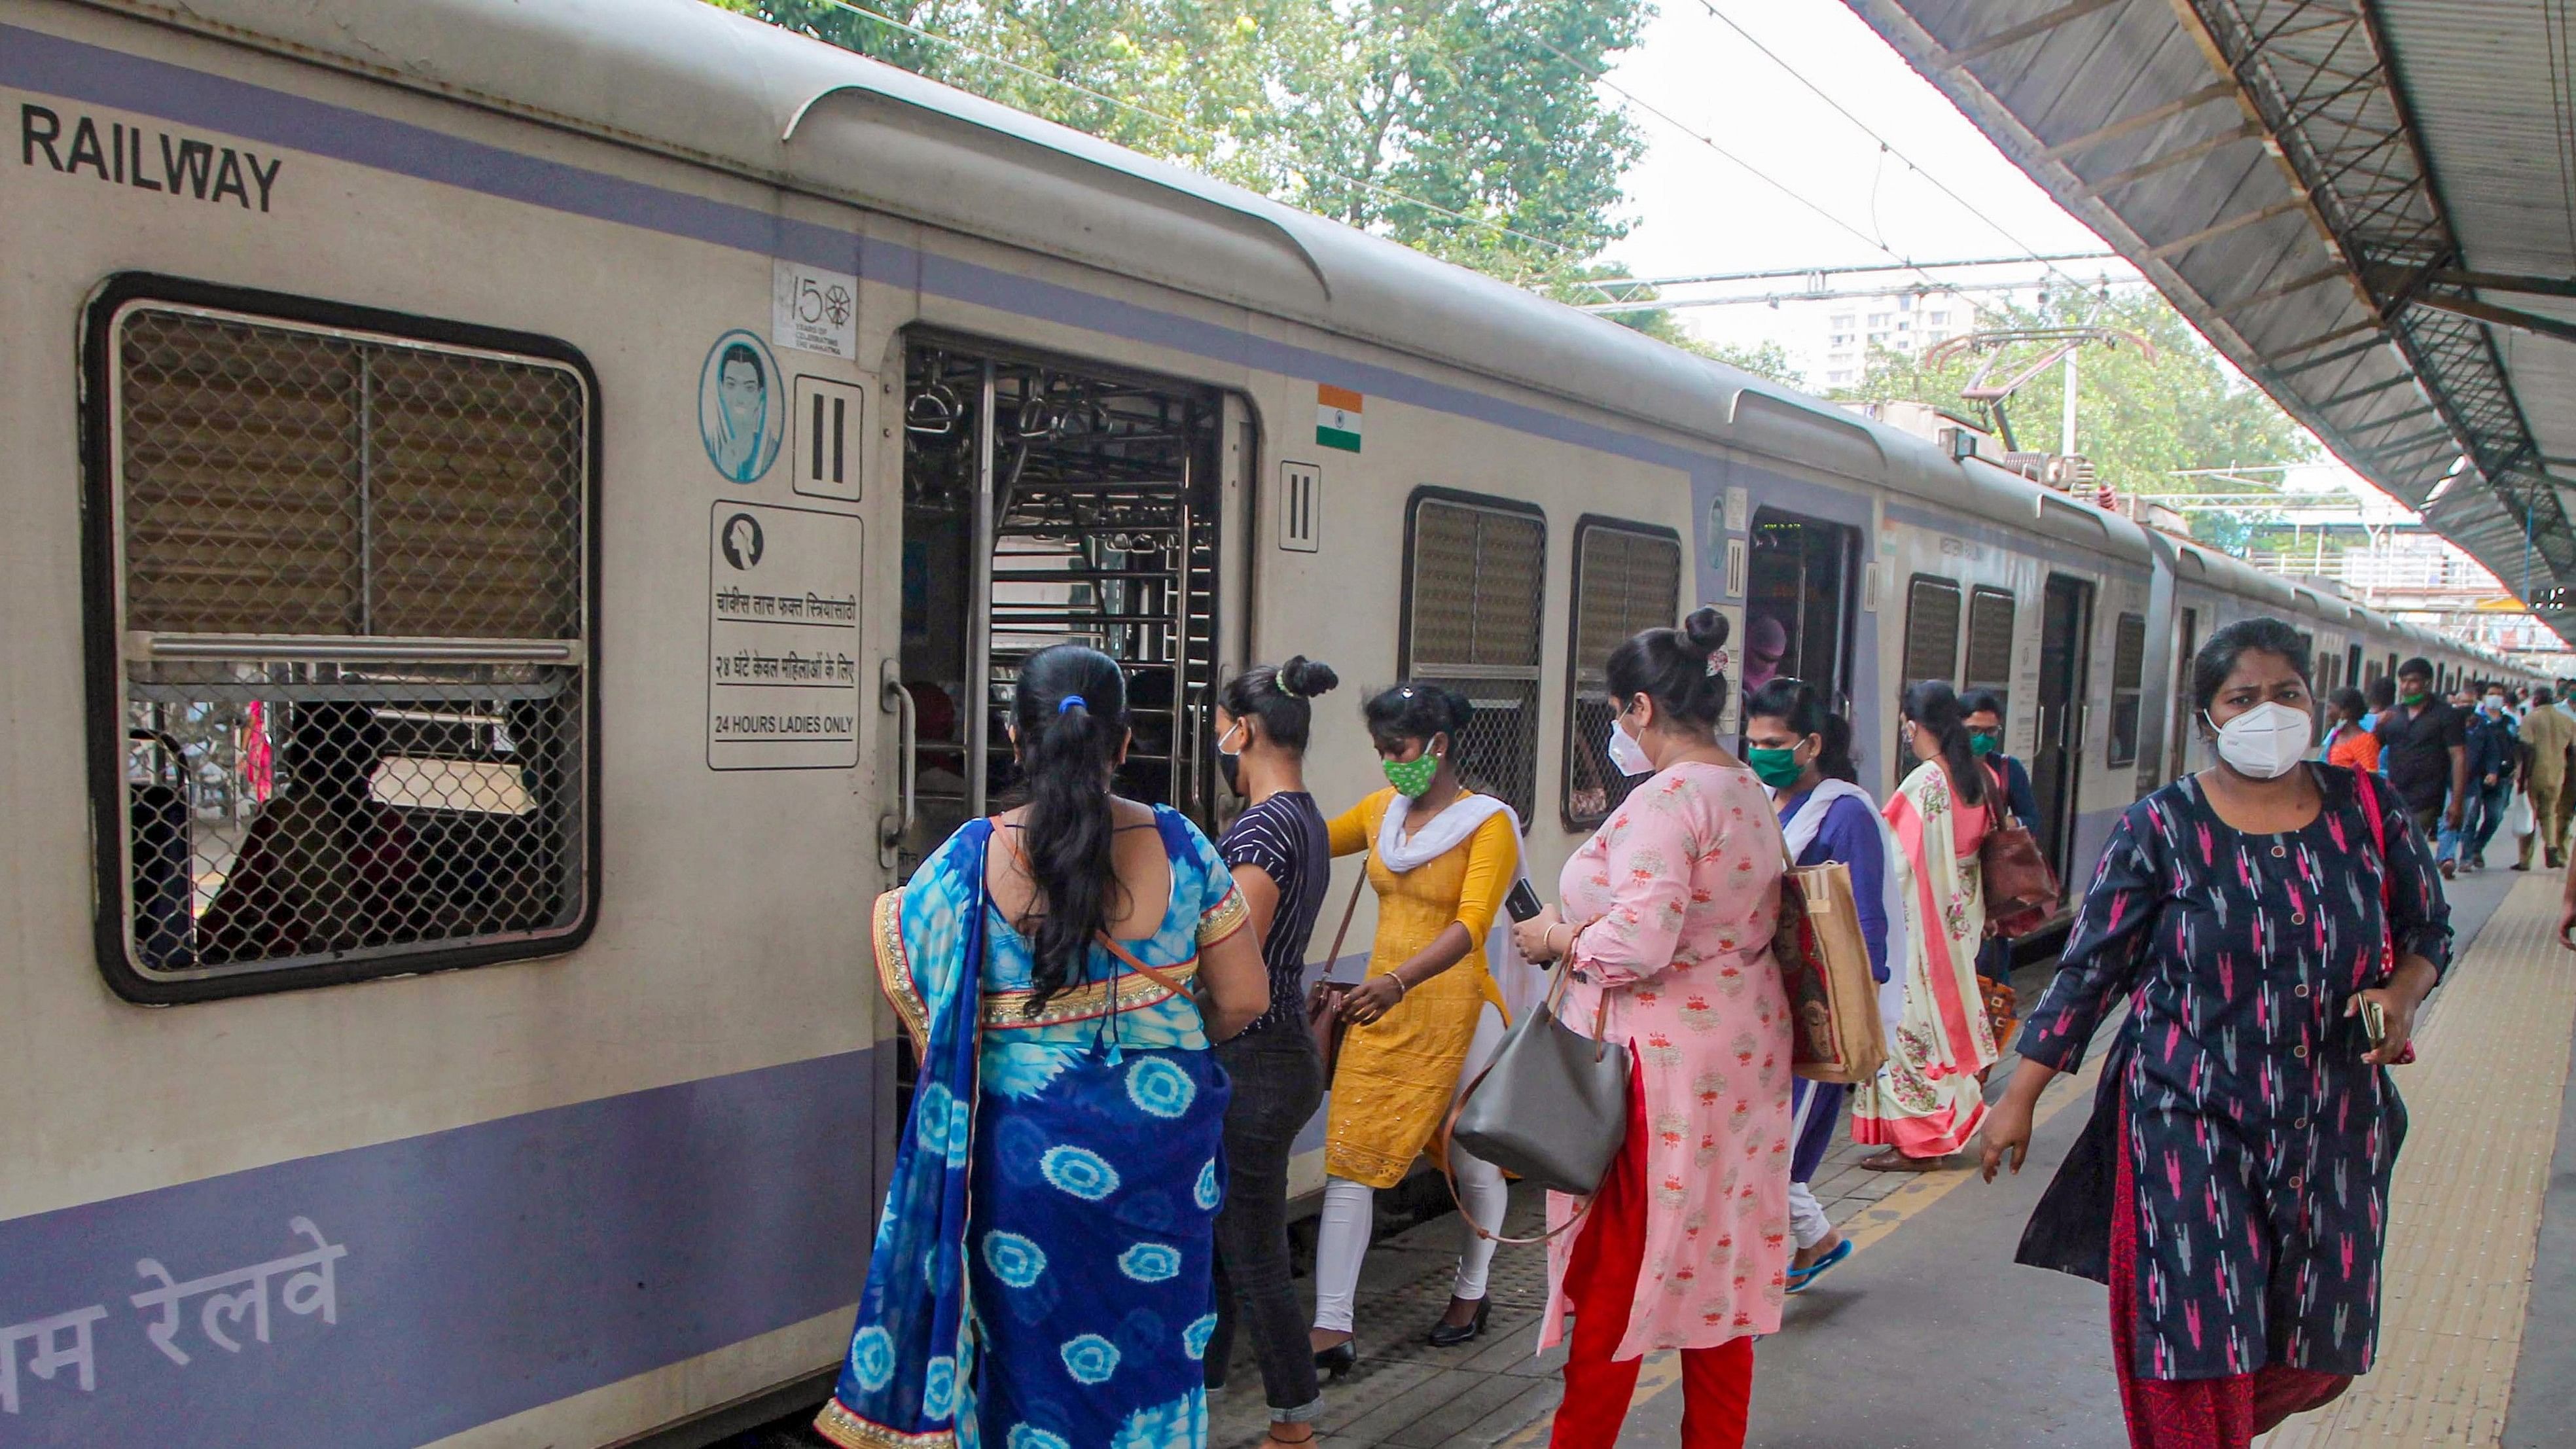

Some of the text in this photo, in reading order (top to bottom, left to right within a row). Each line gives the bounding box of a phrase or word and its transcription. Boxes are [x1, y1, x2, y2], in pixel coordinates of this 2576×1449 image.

[22, 103, 282, 212] RAILWAY
[753, 596, 775, 615] तास
[778, 597, 803, 617] फक्त
[715, 656, 730, 678] २४
[753, 649, 778, 678] केवल
[781, 651, 823, 681] महिलाओं
[825, 653, 834, 679] के
[837, 653, 854, 683] लिए
[715, 715, 853, 734] 24 HOURS LADIES ONLY
[130, 1215, 348, 1365] रेलवे
